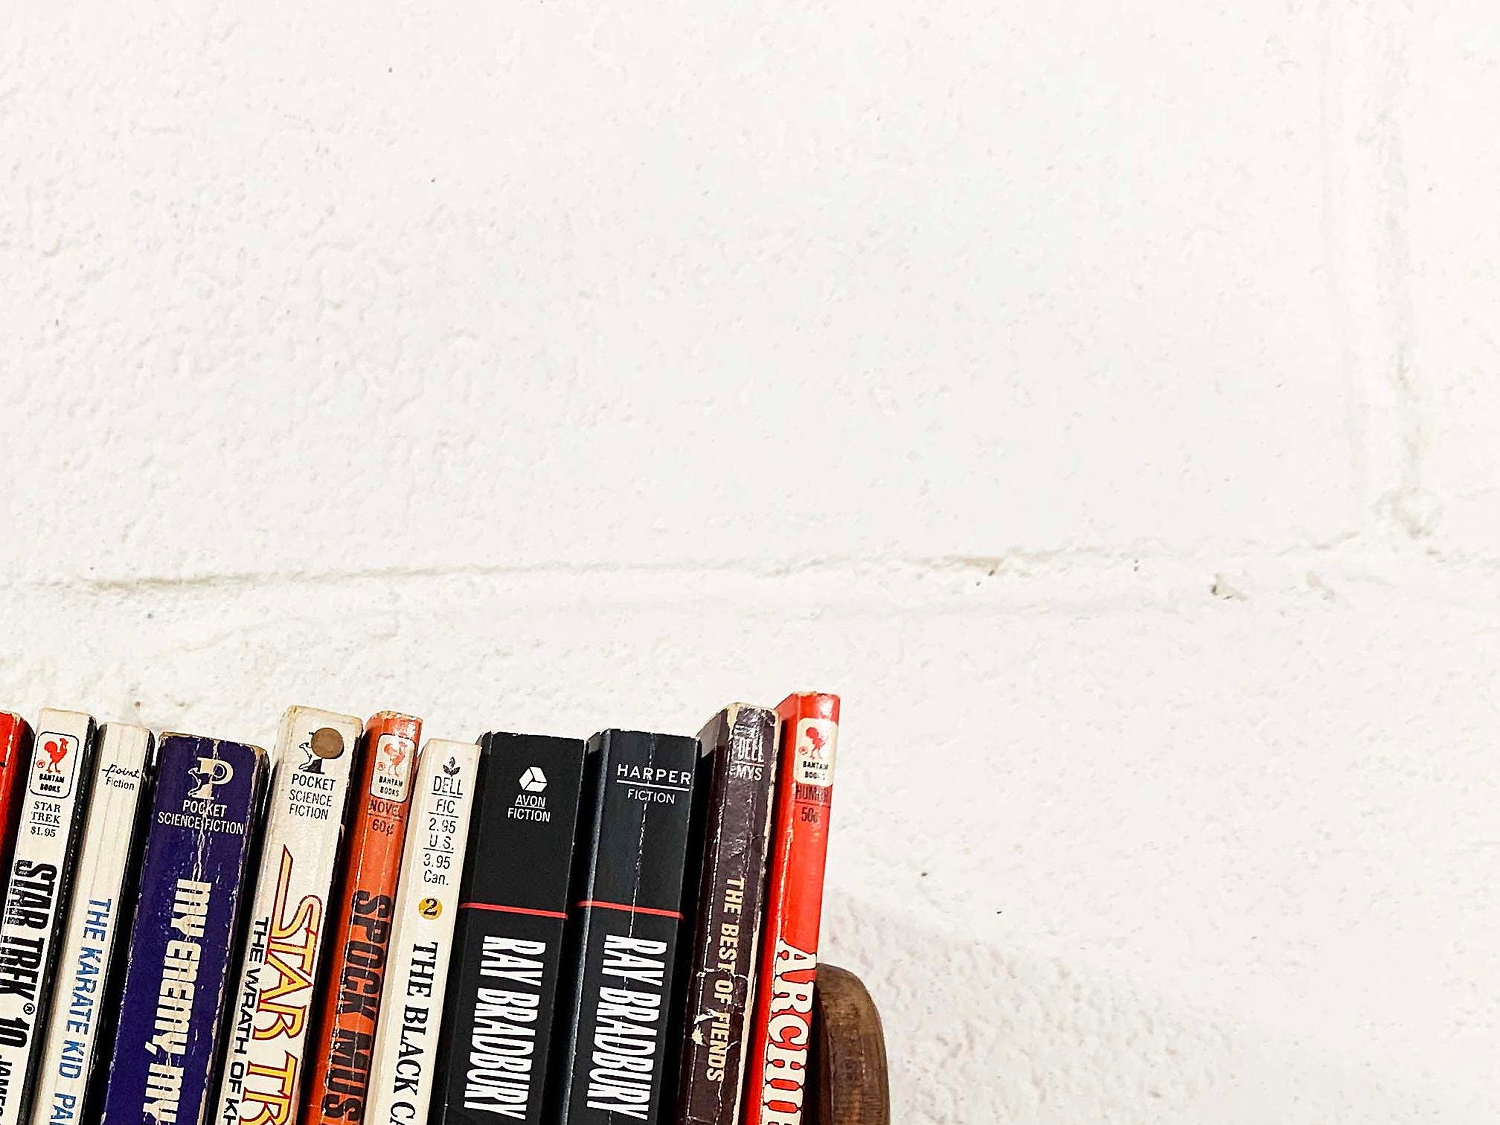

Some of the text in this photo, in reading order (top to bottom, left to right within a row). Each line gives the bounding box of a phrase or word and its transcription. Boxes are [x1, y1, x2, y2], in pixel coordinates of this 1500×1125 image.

[738, 735, 765, 764] DELL
[39, 774, 65, 784] BANTAM
[291, 772, 336, 792] POCKET
[378, 774, 404, 788] BANTAM
[616, 762, 692, 785] HARPER
[735, 766, 762, 781] MYS
[40, 784, 60, 793] BOOKS
[106, 778, 135, 791] Fiction
[378, 786, 400, 798] BOOKS
[433, 776, 464, 796] DELL
[288, 789, 332, 808] SCIENCE
[515, 794, 546, 808] AVON
[627, 788, 676, 805] FICTION
[34, 800, 60, 814] STAR
[182, 800, 228, 818] POCKET
[288, 803, 328, 820] FICTION
[436, 798, 456, 814] FIC
[507, 807, 550, 823] FICTION
[31, 810, 60, 824] TREK
[157, 811, 244, 835] SCIENCE FICTION
[428, 818, 456, 834] 2.95
[30, 826, 56, 838] $1.95
[429, 834, 454, 850] U.S.
[424, 853, 450, 870] 3.95
[424, 870, 450, 886] Can.
[3, 859, 57, 930] STAR
[424, 898, 438, 916] 2
[82, 898, 112, 942] THE
[248, 916, 270, 964] THE
[252, 844, 322, 1041] STAR
[338, 890, 392, 1022] SPOCK
[406, 942, 438, 1000] THE
[706, 876, 745, 1082] THE BEST OF FIENDS
[64, 947, 103, 1036] KARATE
[231, 968, 262, 1056] WRATH
[463, 935, 548, 1121] RAY BRADBURY
[586, 934, 668, 1121] RAY BRADBURY
[393, 1004, 430, 1096] BLACK
[58, 1039, 86, 1080] KID
[227, 1062, 246, 1094] OF
